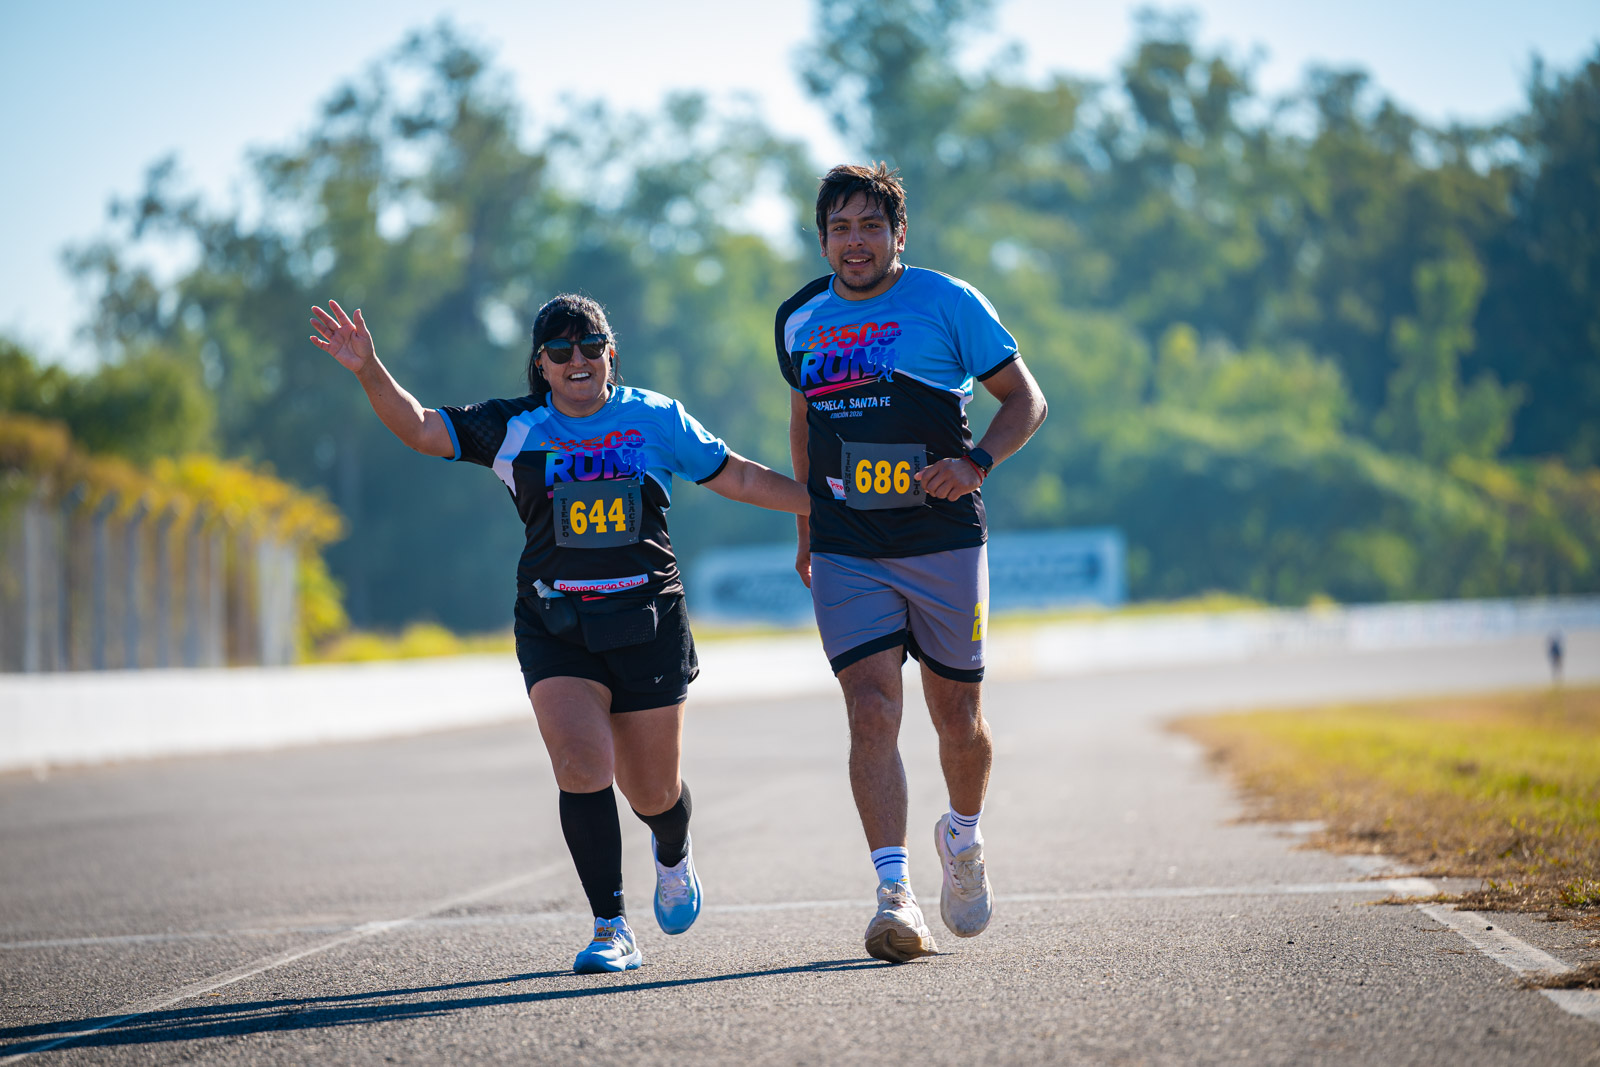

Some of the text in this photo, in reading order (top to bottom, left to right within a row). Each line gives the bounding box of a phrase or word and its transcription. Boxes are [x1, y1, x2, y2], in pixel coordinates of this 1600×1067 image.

[870, 329, 902, 339] MILLAS
[849, 397, 878, 409] SANTA
[879, 396, 891, 407] FE
[855, 459, 911, 495] 686
[913, 455, 921, 496] EXTO
[560, 497, 570, 538] TIEMPO
[570, 498, 626, 535] 644
[627, 492, 636, 533] EXACTO
